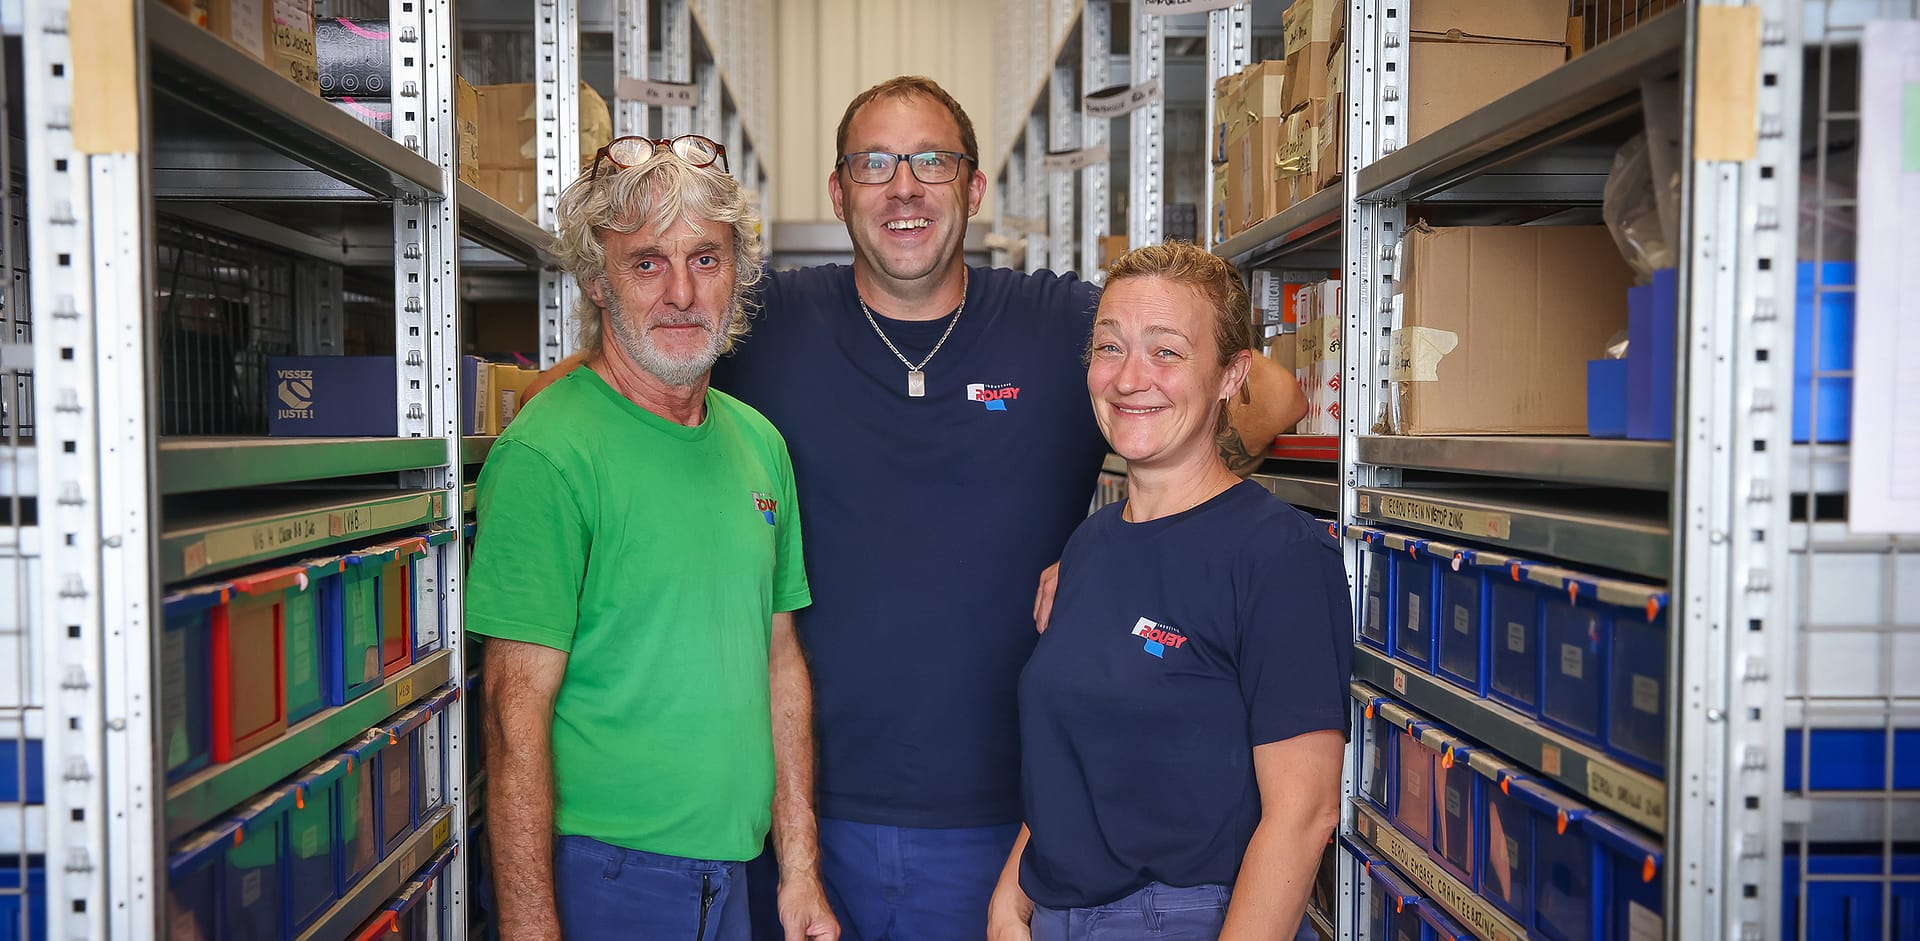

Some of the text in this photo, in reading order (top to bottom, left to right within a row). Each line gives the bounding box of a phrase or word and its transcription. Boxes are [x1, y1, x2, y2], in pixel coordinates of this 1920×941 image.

[277, 369, 313, 379] VISSEZ
[975, 387, 1020, 402] ROUBY
[278, 409, 308, 420] JUSTE
[1139, 624, 1188, 649] ROUBY
